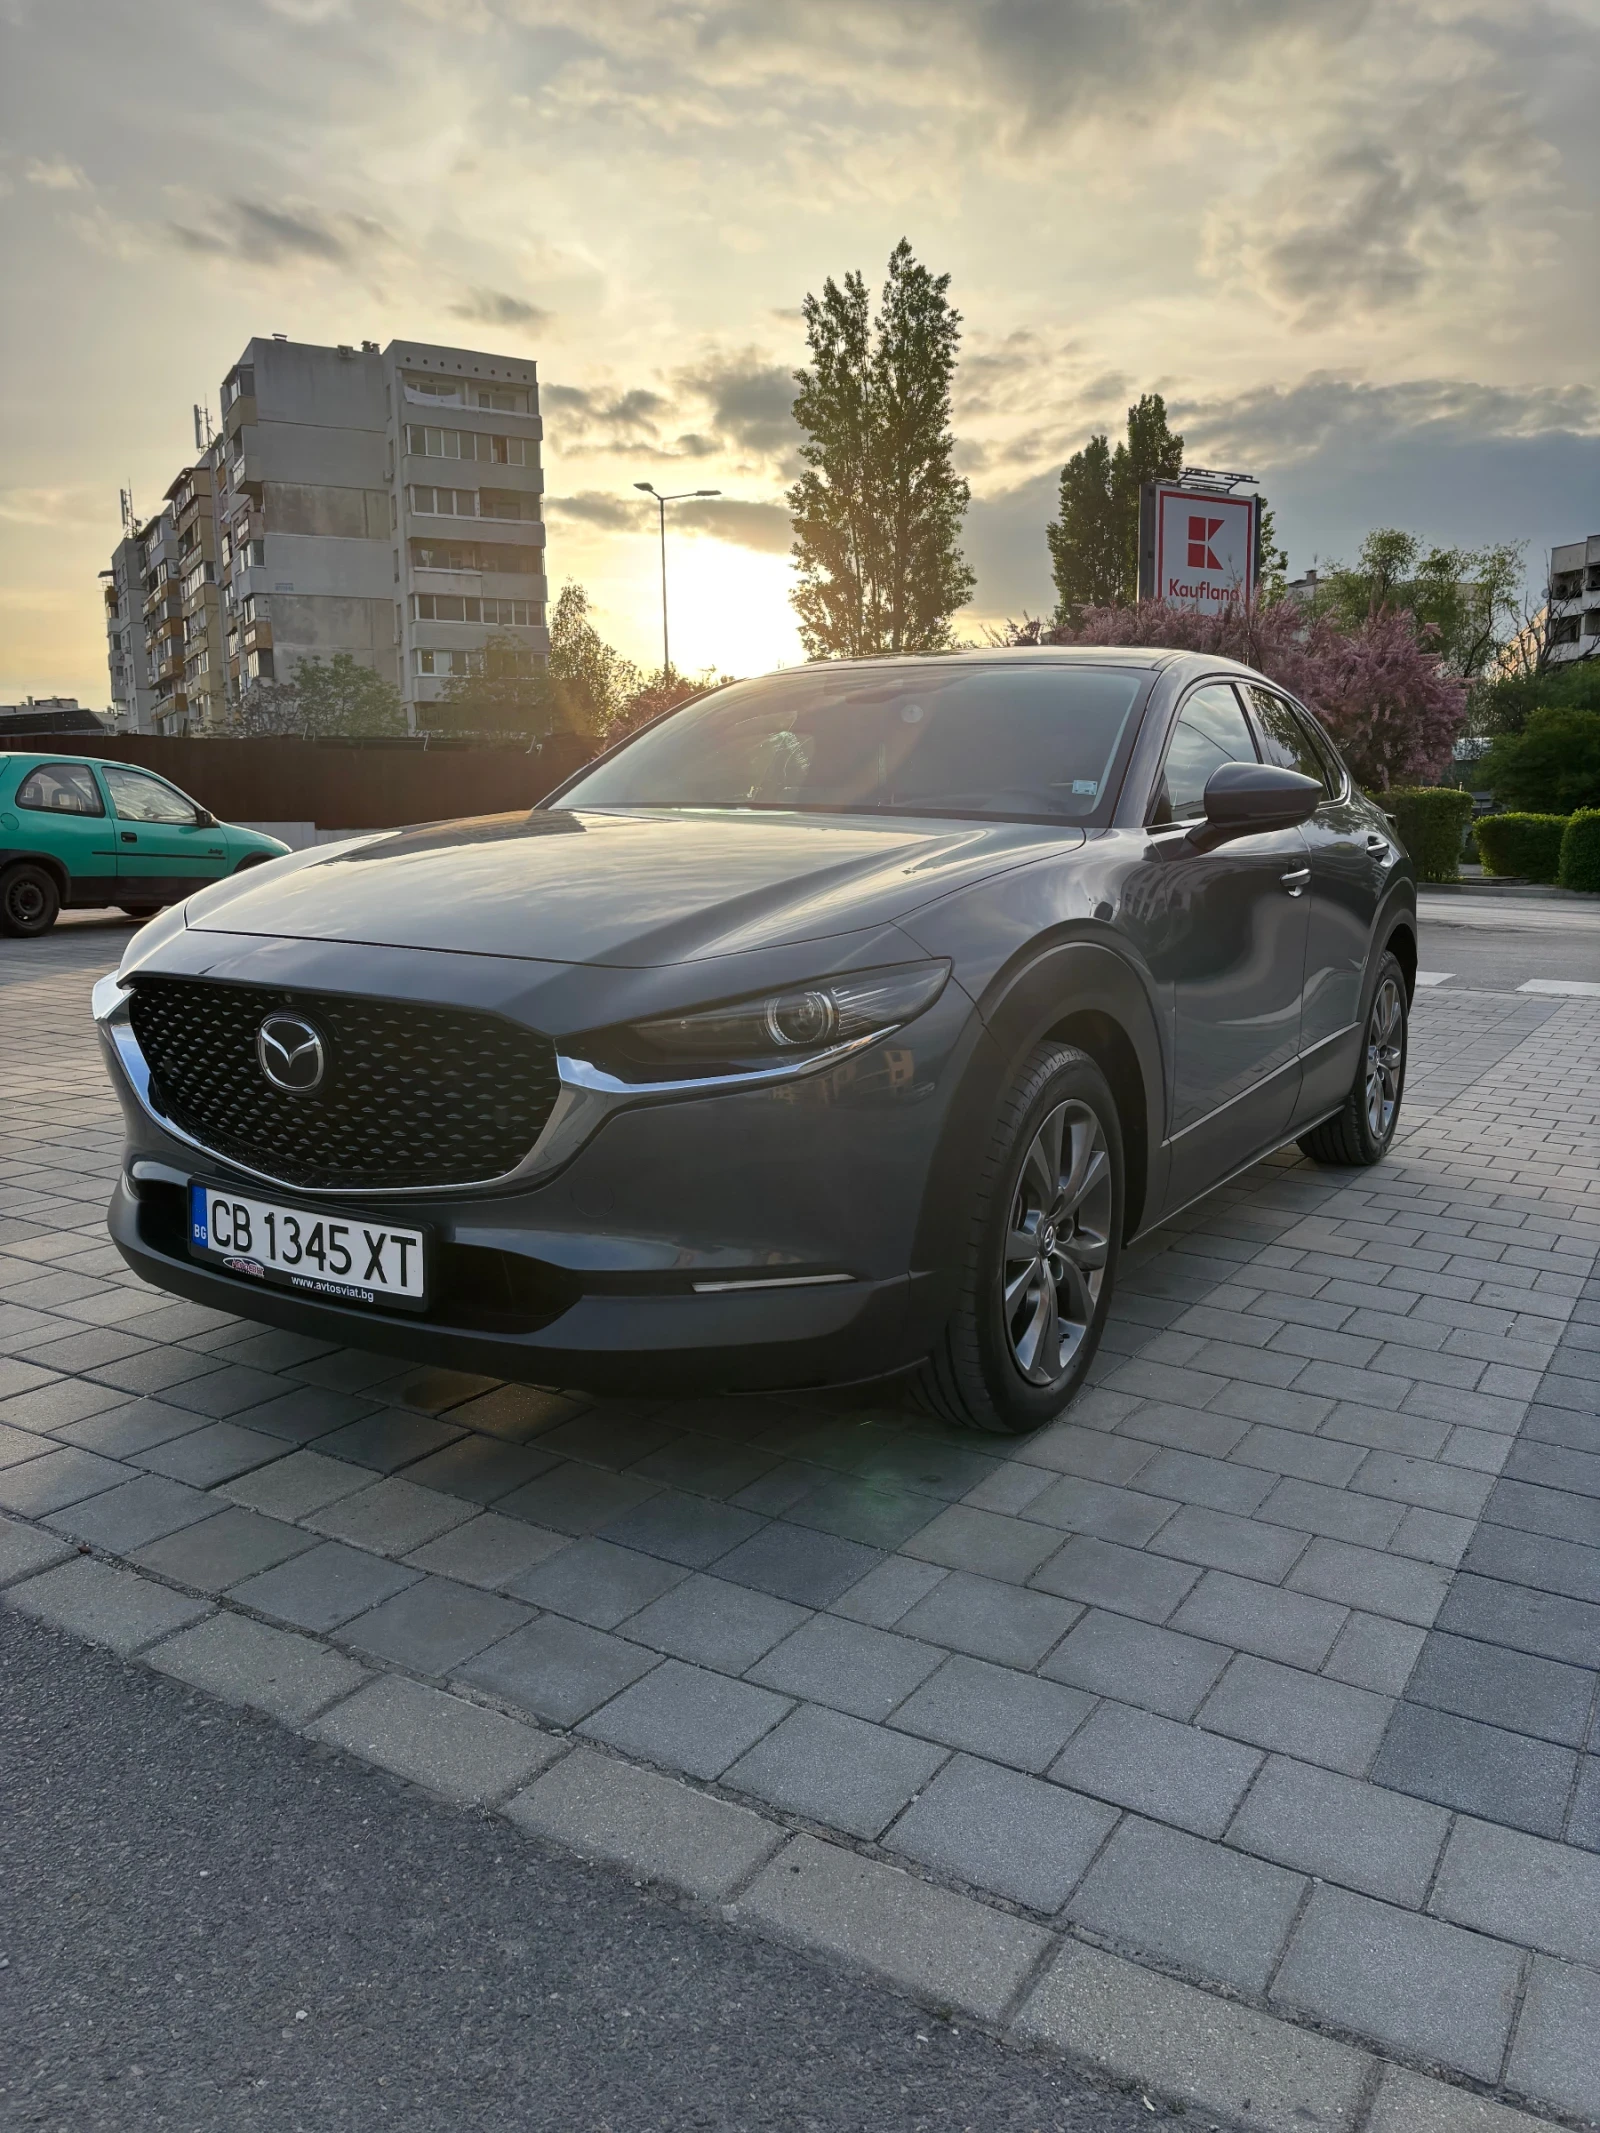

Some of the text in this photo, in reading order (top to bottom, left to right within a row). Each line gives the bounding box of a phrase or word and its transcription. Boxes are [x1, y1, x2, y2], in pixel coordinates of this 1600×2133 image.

[194, 1224, 207, 1240] BG
[211, 1200, 417, 1287] CB 1345 XT
[291, 1276, 374, 1302] www.avtosviat.bg
